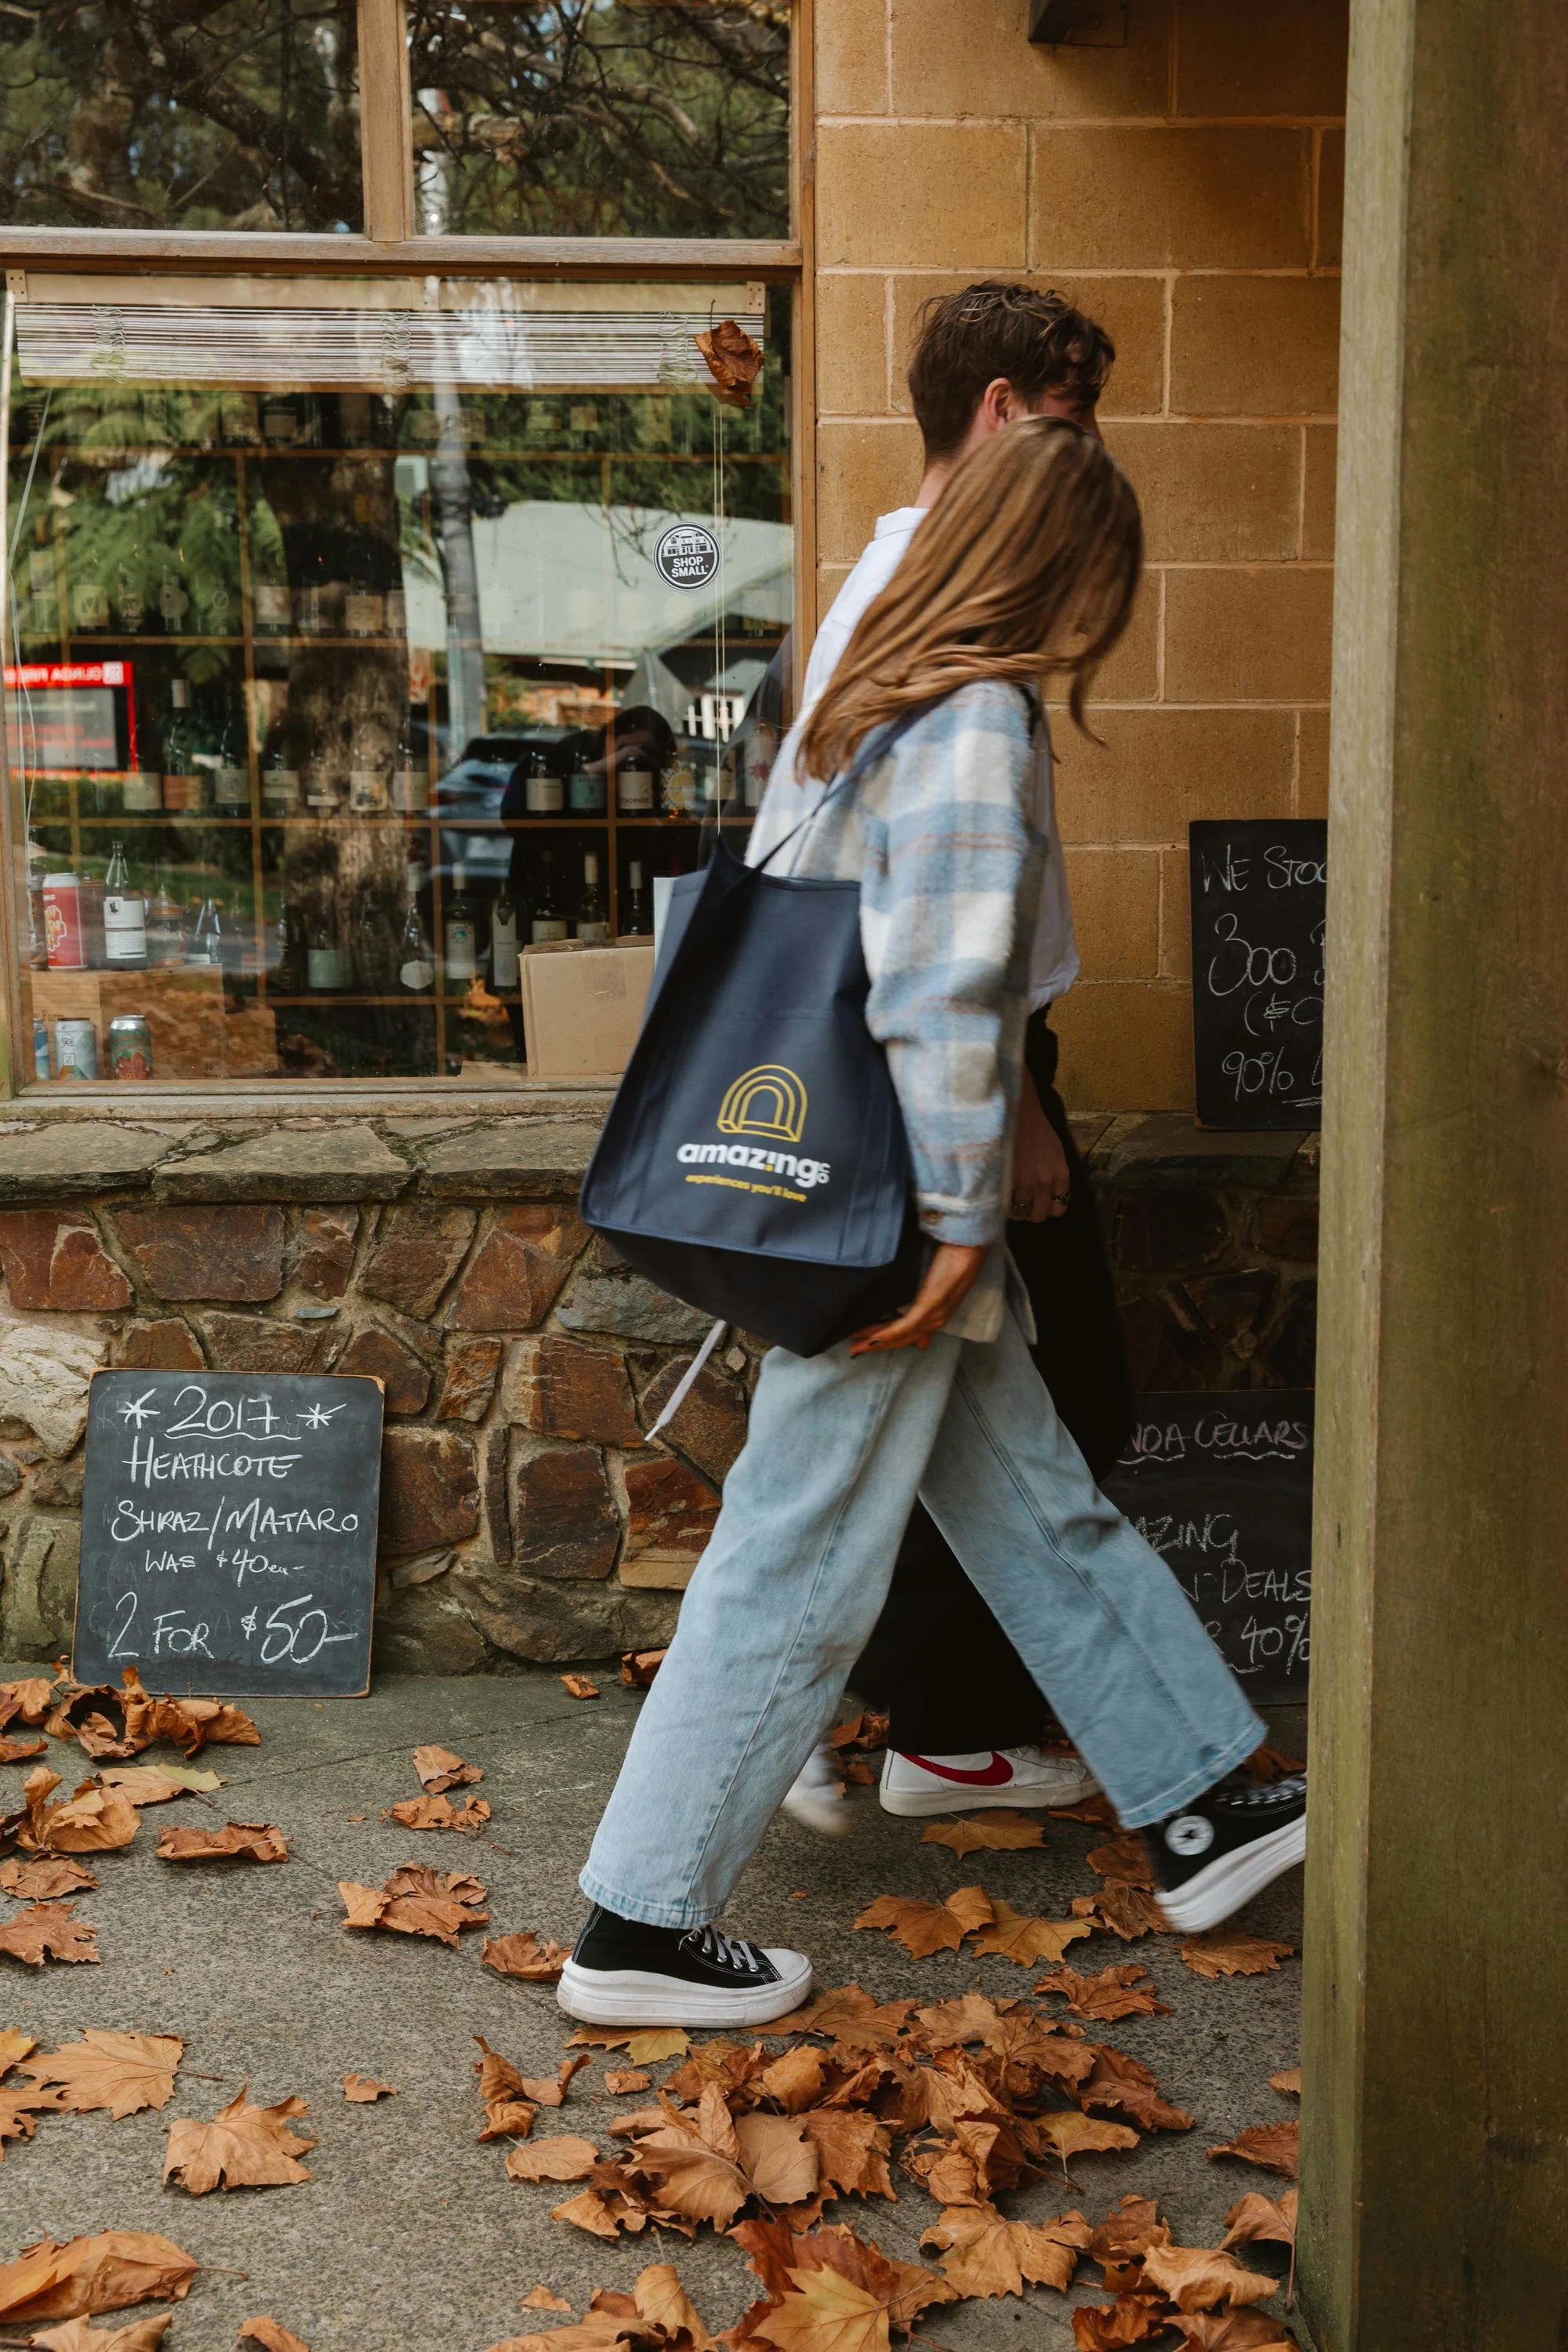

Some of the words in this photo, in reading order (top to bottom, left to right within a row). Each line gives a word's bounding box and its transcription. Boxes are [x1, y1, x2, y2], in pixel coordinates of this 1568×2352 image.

[671, 565, 707, 578] SMALL
[673, 556, 703, 568] SHOP
[1200, 844, 1251, 893] WE
[1208, 913, 1298, 996] 300
[1221, 1045, 1294, 1102] 90%
[167, 1385, 280, 1434] 2017
[1195, 1410, 1310, 1450] CELLARS
[122, 1436, 303, 1488] HEATHCOTE
[145, 1550, 196, 1573] WAS
[1220, 1558, 1312, 1604] DEALS
[107, 1592, 140, 1659] 2
[153, 1610, 216, 1659] FOR
[1240, 1611, 1311, 1675] 40%
